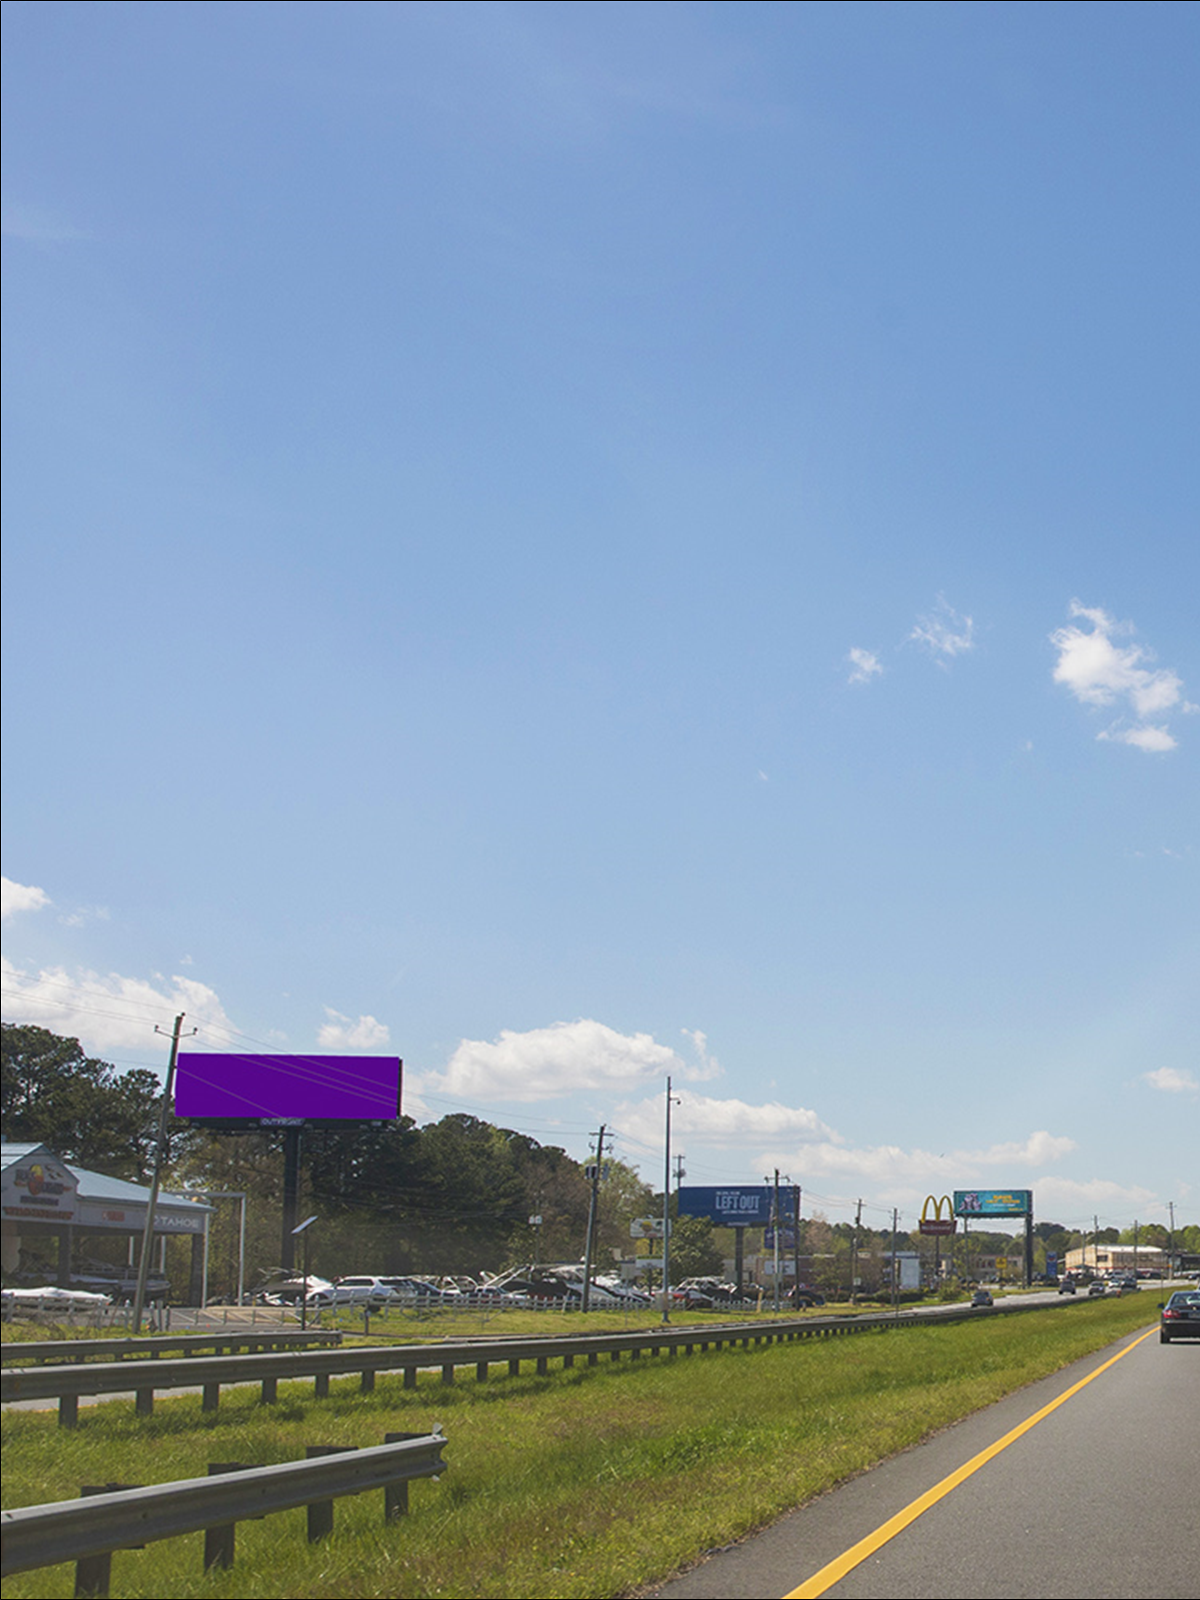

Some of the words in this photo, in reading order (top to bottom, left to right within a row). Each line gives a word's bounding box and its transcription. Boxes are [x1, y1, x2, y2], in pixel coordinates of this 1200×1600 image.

[716, 1196, 739, 1210] LEFT
[740, 1195, 761, 1210] OUT
[161, 1216, 200, 1228] TAHOE
